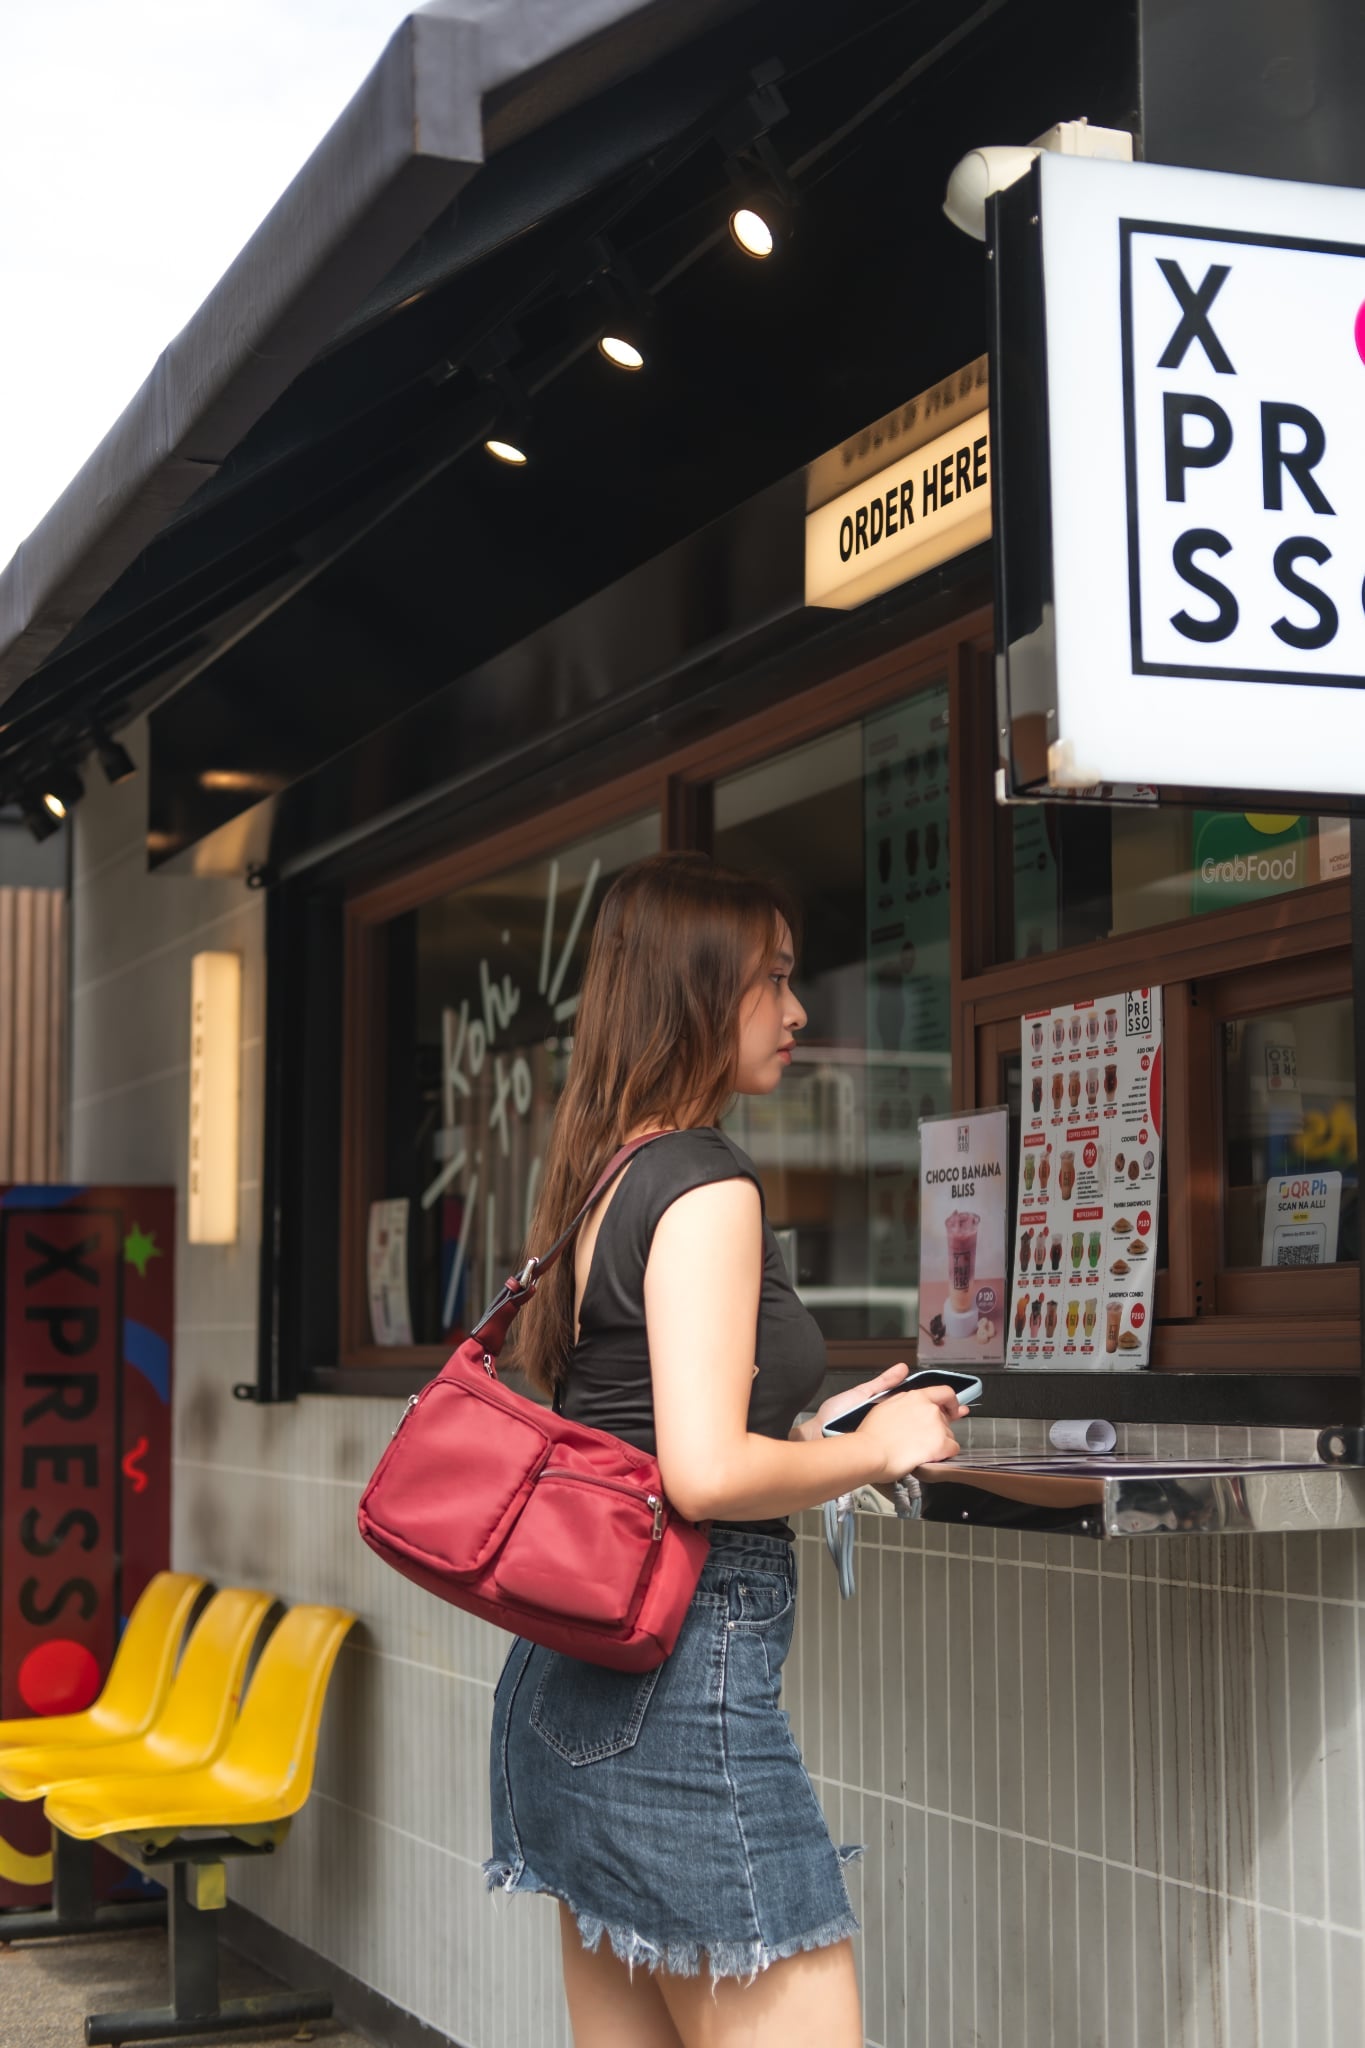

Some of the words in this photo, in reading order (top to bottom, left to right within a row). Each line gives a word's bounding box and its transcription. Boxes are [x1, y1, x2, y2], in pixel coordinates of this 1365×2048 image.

[1155, 257, 1238, 375] X
[839, 479, 914, 563] ORDER
[922, 434, 988, 518] HERE
[1169, 528, 1365, 651] SS
[1201, 851, 1297, 884] GrabFood
[1128, 1001, 1148, 1017] PRE
[1128, 1016, 1150, 1032] SSO
[925, 1167, 960, 1185] CHOCO
[961, 1161, 1002, 1181] BANANA
[951, 1182, 975, 1199] BLISS
[1290, 1179, 1310, 1199] QR
[1311, 1178, 1328, 1196] Ph
[1277, 1202, 1297, 1212] SCAN
[1298, 1201, 1309, 1210] NA
[18, 1231, 101, 1627] XPRESS
